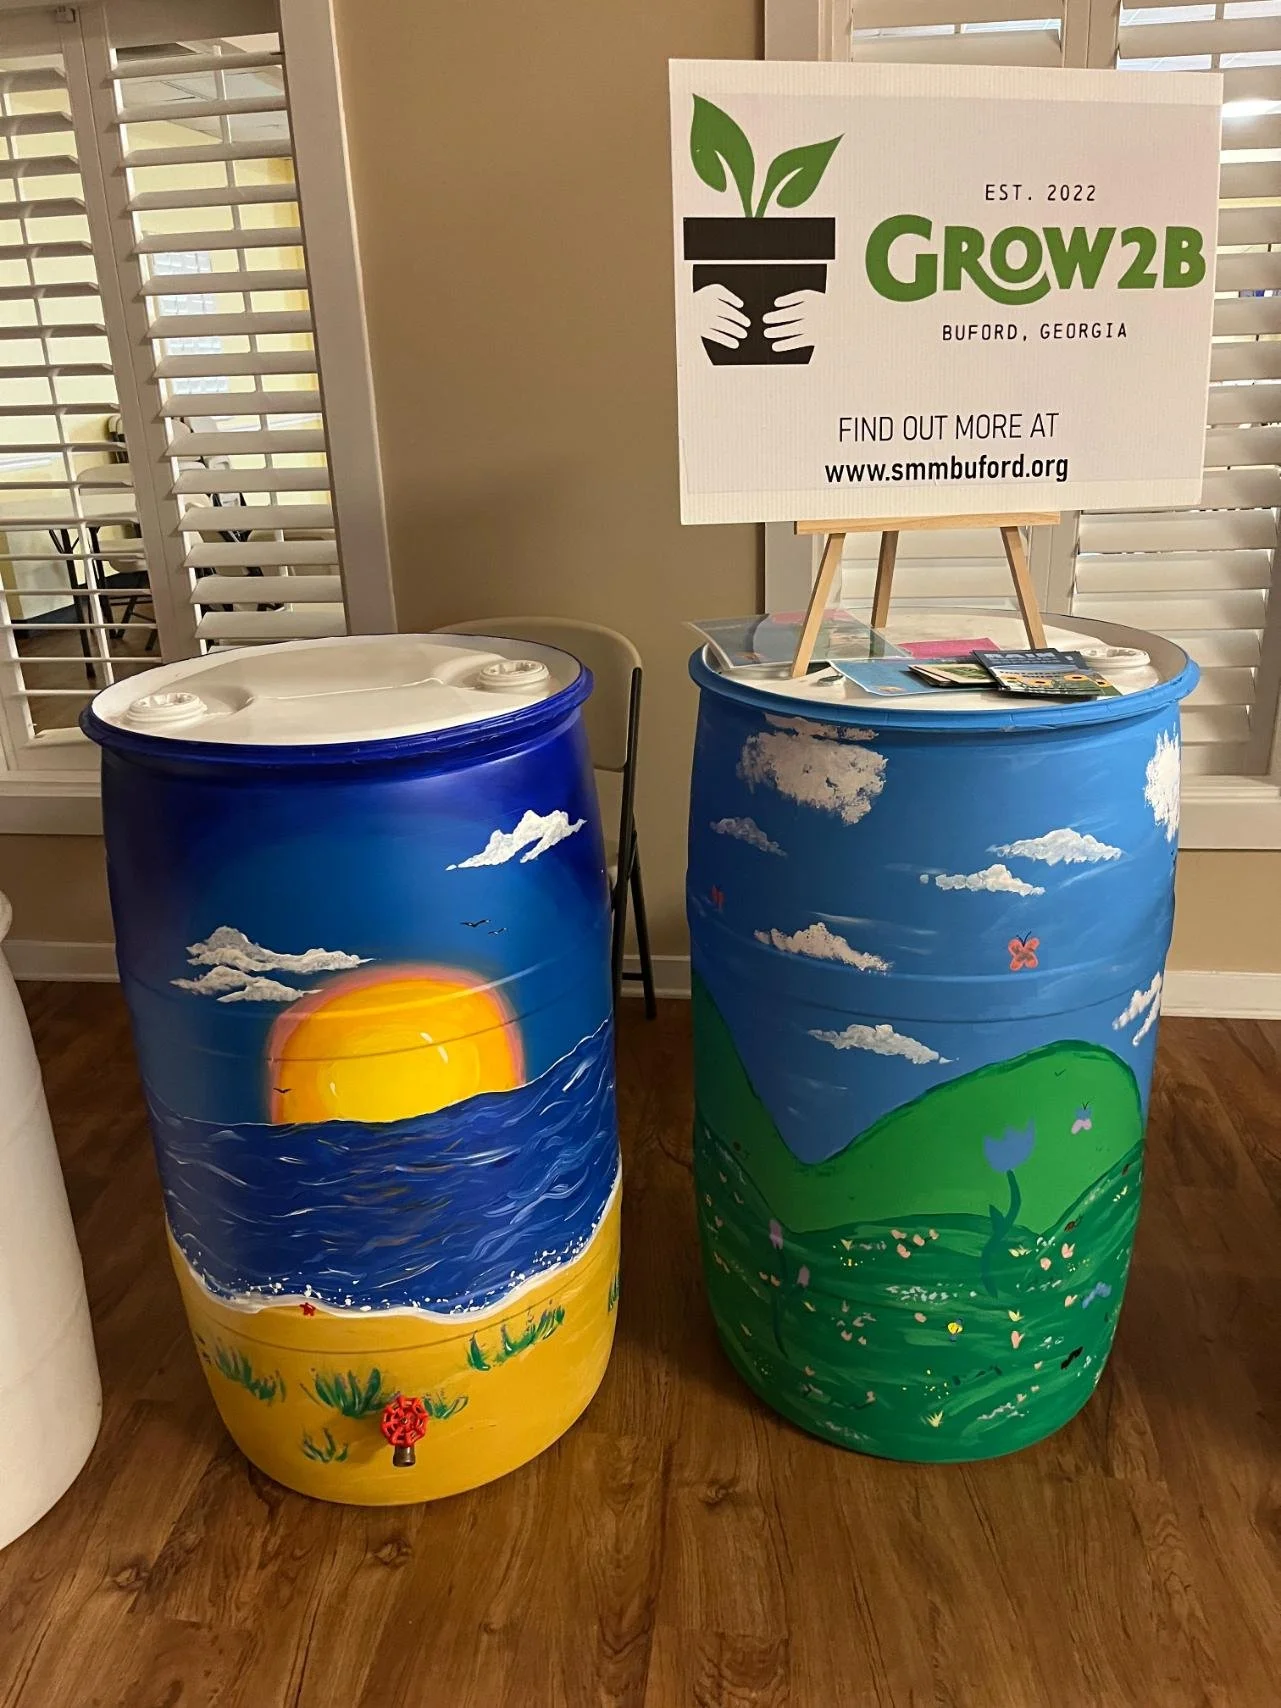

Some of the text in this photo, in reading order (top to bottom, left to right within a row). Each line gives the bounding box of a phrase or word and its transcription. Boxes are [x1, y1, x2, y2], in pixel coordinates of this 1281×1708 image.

[985, 183, 1096, 202] EST. 2022
[865, 213, 1207, 306] GROW2B
[942, 322, 1127, 342] BUFORD, GEORGIA
[839, 412, 1060, 442] FIND OUT MORE AT
[824, 453, 1069, 483] www.smmbuford.org
